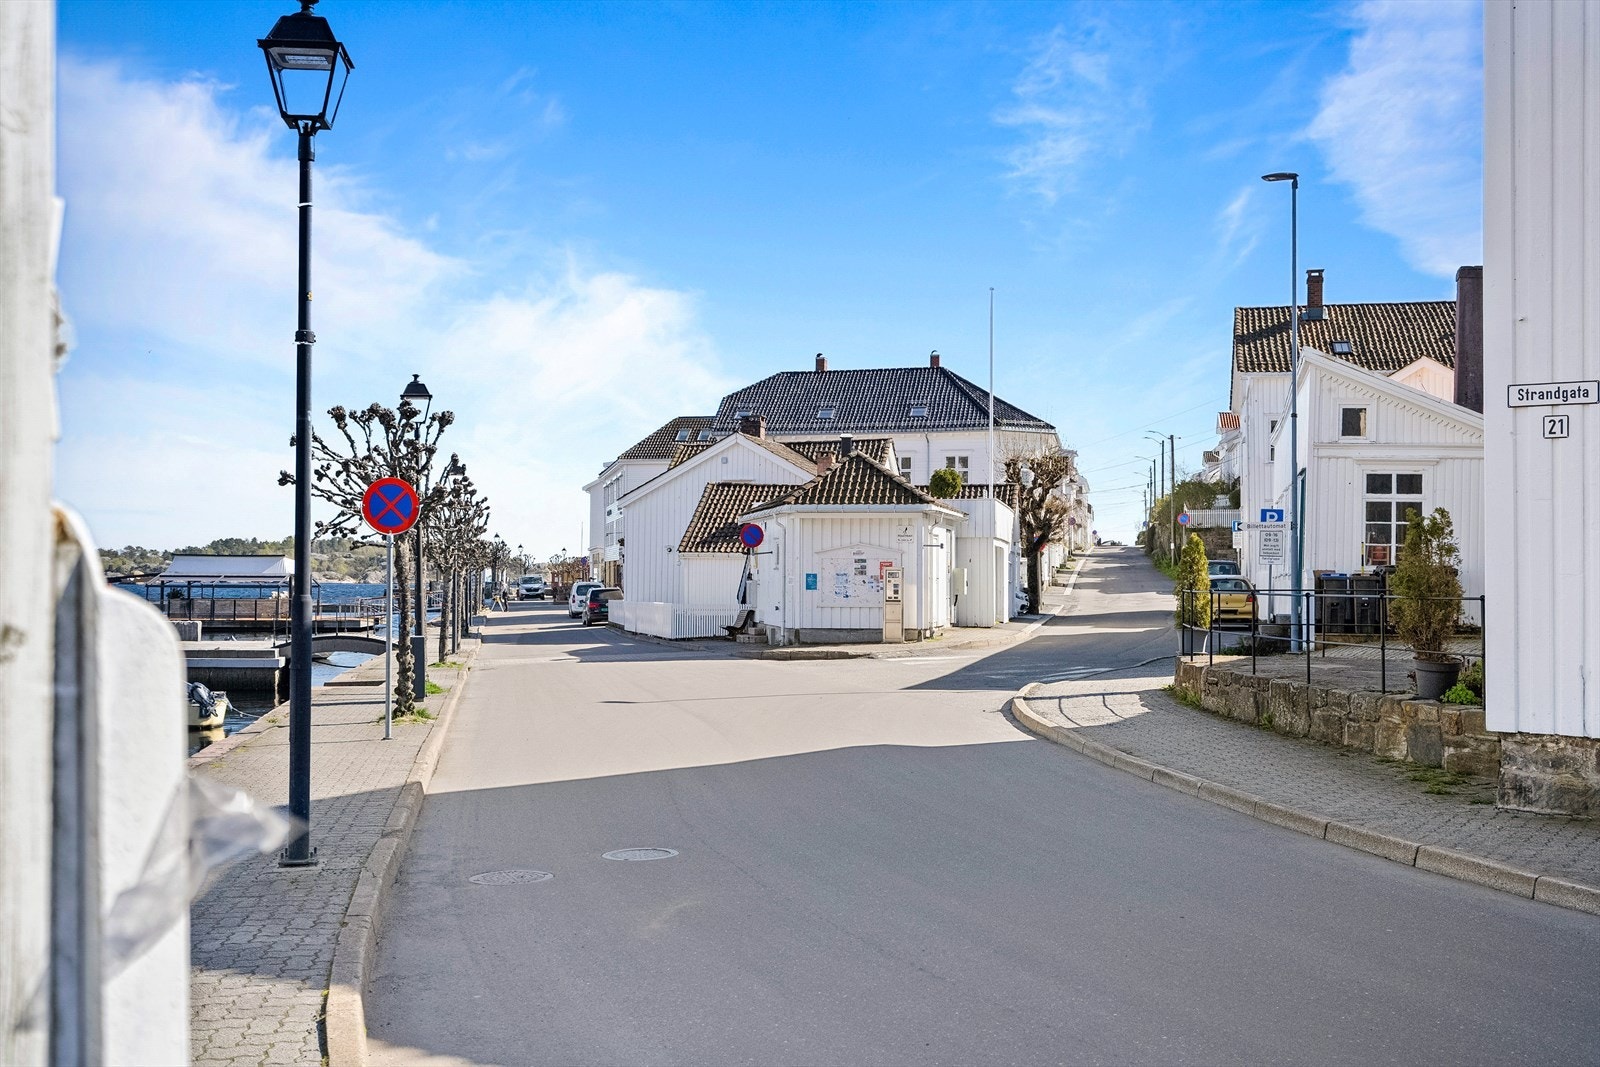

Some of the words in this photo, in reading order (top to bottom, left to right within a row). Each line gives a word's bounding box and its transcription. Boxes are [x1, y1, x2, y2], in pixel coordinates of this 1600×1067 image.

[1517, 386, 1589, 402] Strandgata
[1548, 418, 1564, 435] 21
[1266, 511, 1278, 522] P
